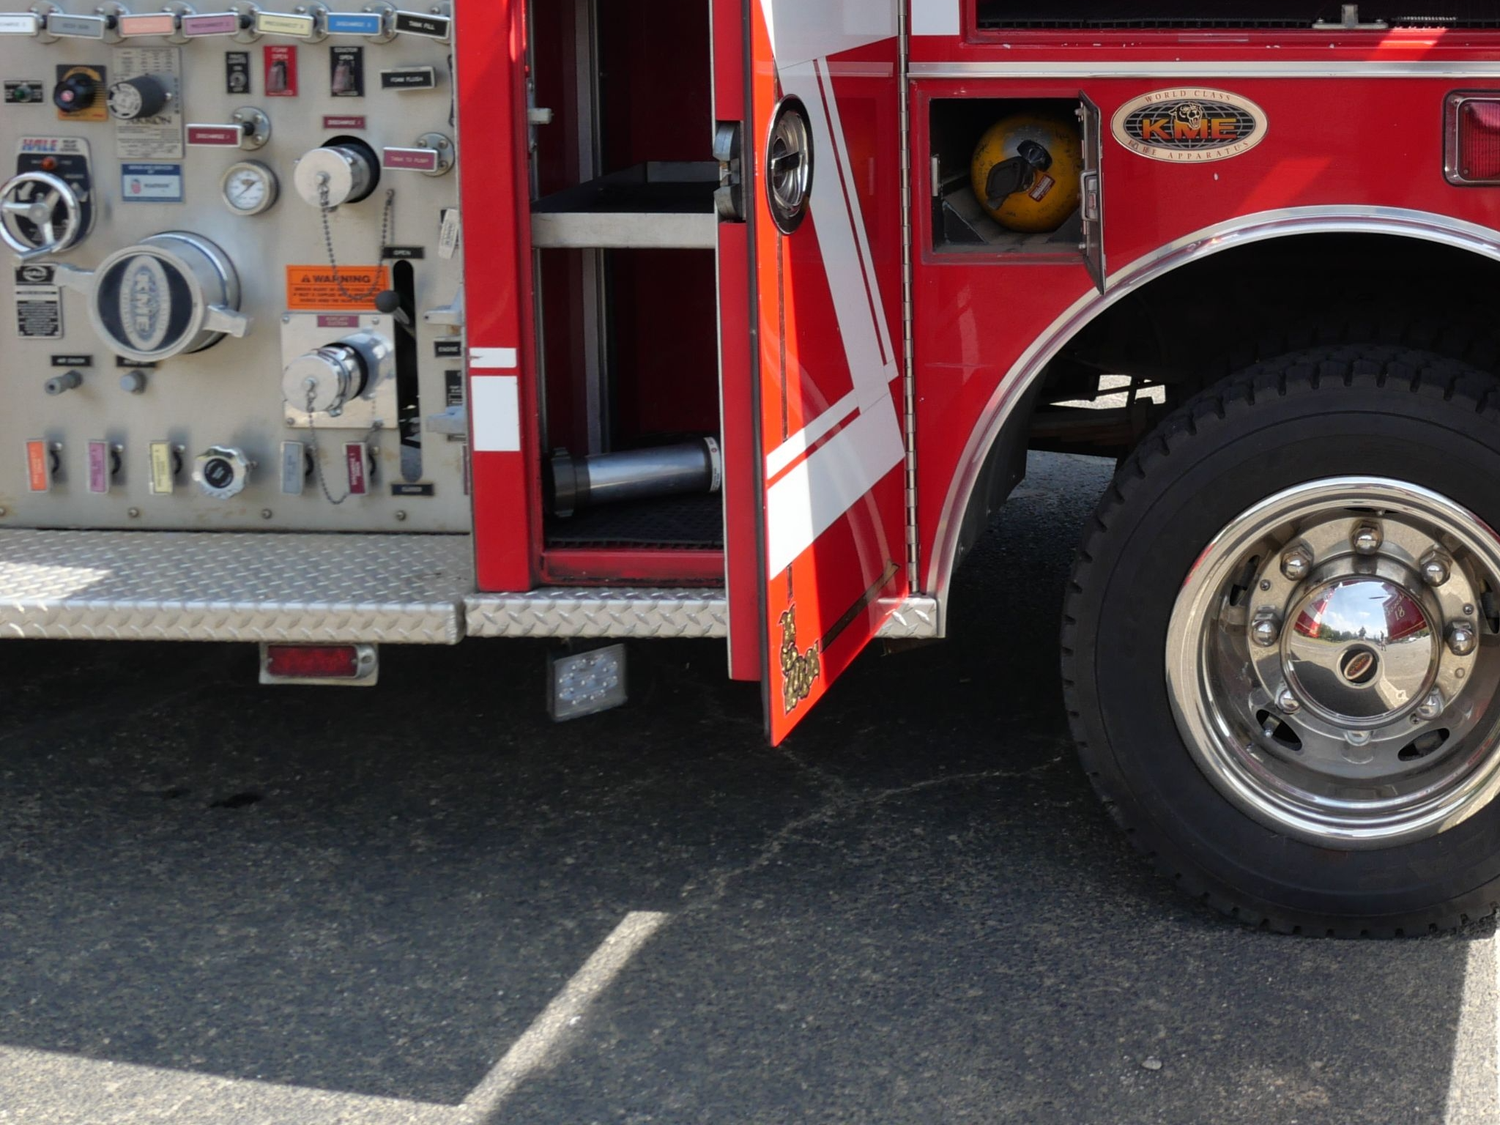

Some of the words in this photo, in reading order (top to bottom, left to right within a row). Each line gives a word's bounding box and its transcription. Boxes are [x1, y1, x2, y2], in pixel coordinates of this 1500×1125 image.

[408, 20, 423, 29] TANK
[423, 22, 436, 31] FILL
[1145, 90, 1187, 104] WORLD
[1194, 90, 1231, 102] CLASS
[1141, 117, 1238, 140] KME
[1168, 140, 1250, 160] APPARATUS
[313, 275, 371, 283] WARNING
